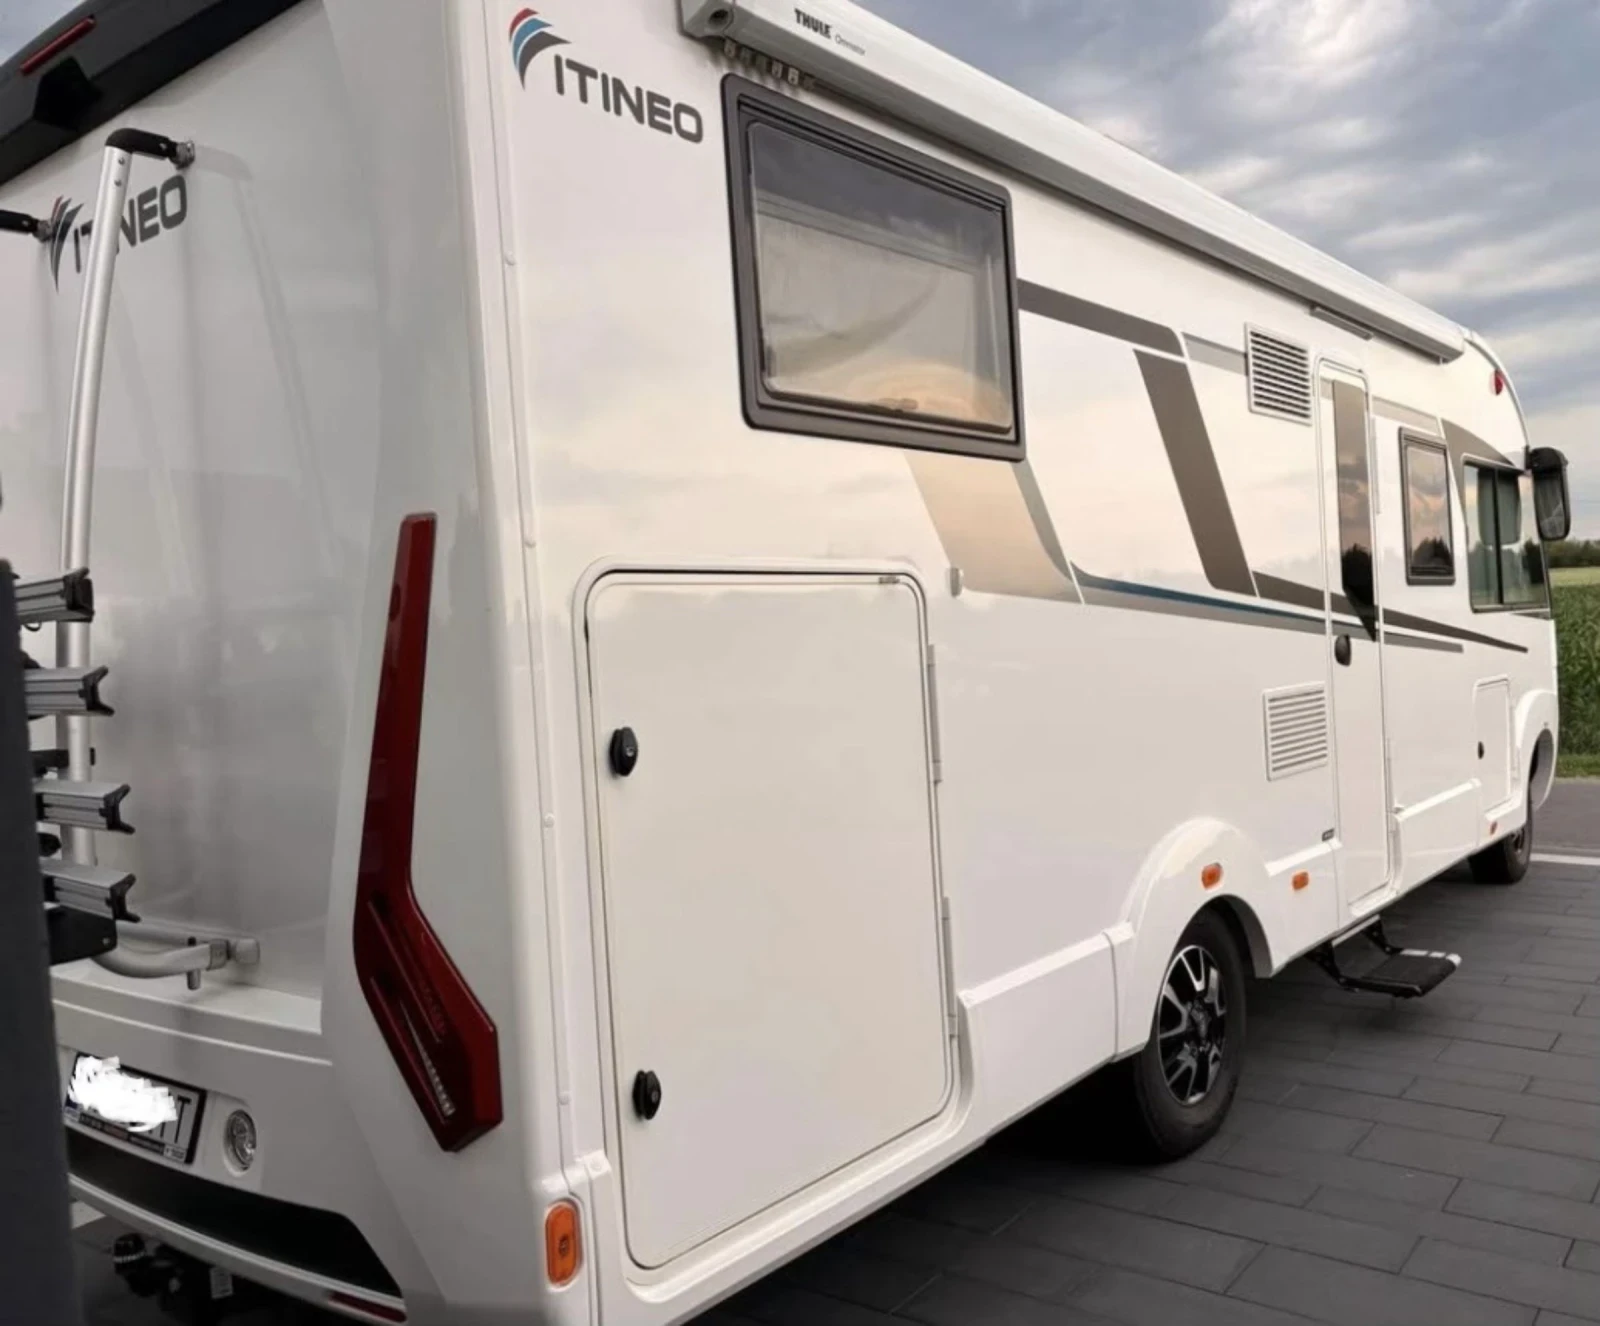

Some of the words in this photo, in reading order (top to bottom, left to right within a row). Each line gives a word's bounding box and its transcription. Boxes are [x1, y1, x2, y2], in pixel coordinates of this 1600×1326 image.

[794, 7, 831, 39] THULE
[554, 54, 703, 144] ITINEO
[74, 175, 187, 274] INEO
